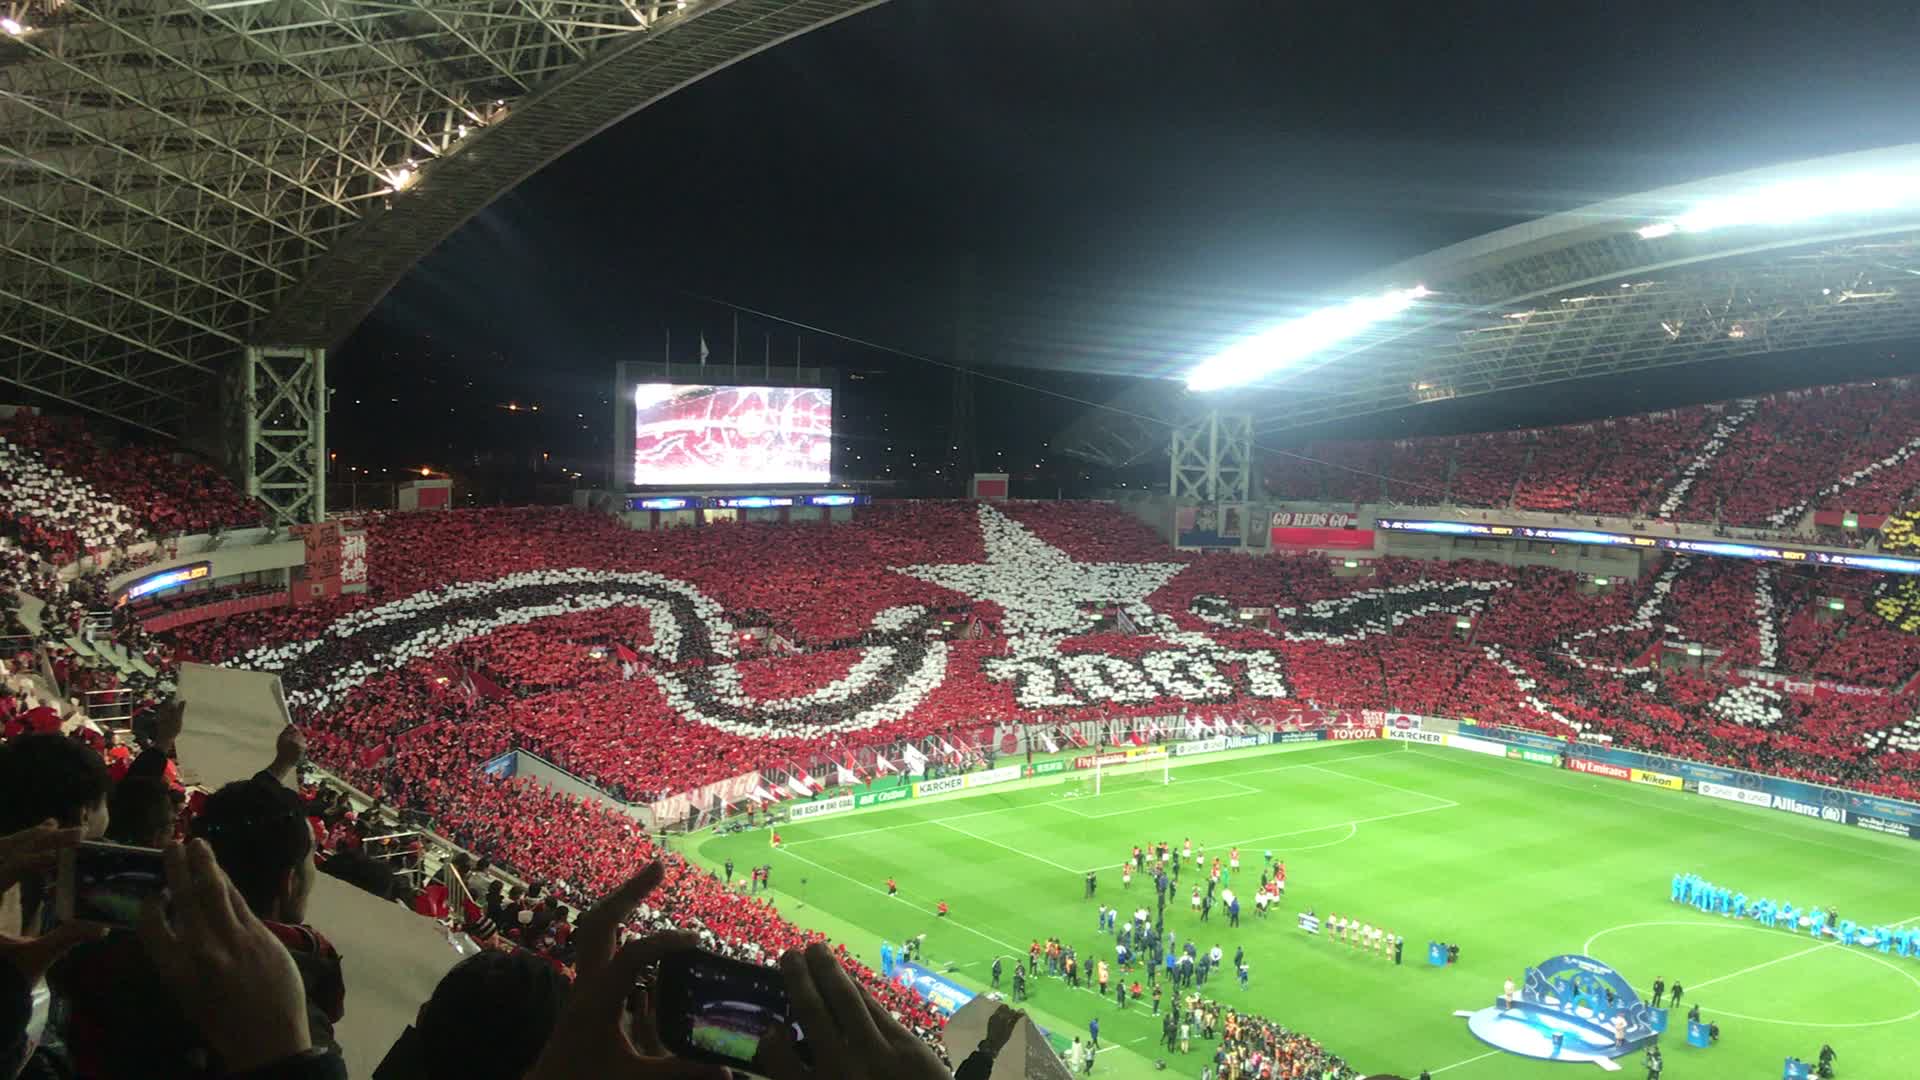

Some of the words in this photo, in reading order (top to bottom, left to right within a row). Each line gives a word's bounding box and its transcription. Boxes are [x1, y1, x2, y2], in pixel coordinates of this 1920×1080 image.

[1272, 512, 1291, 526] GO
[1292, 512, 1328, 527] REDS
[1328, 513, 1348, 527] GO
[1332, 728, 1377, 740] TOYOTA
[1225, 734, 1257, 750] Allianz
[1587, 762, 1628, 778] Emirates
[1641, 772, 1672, 787] Nikon
[1772, 794, 1820, 817] Allianz
